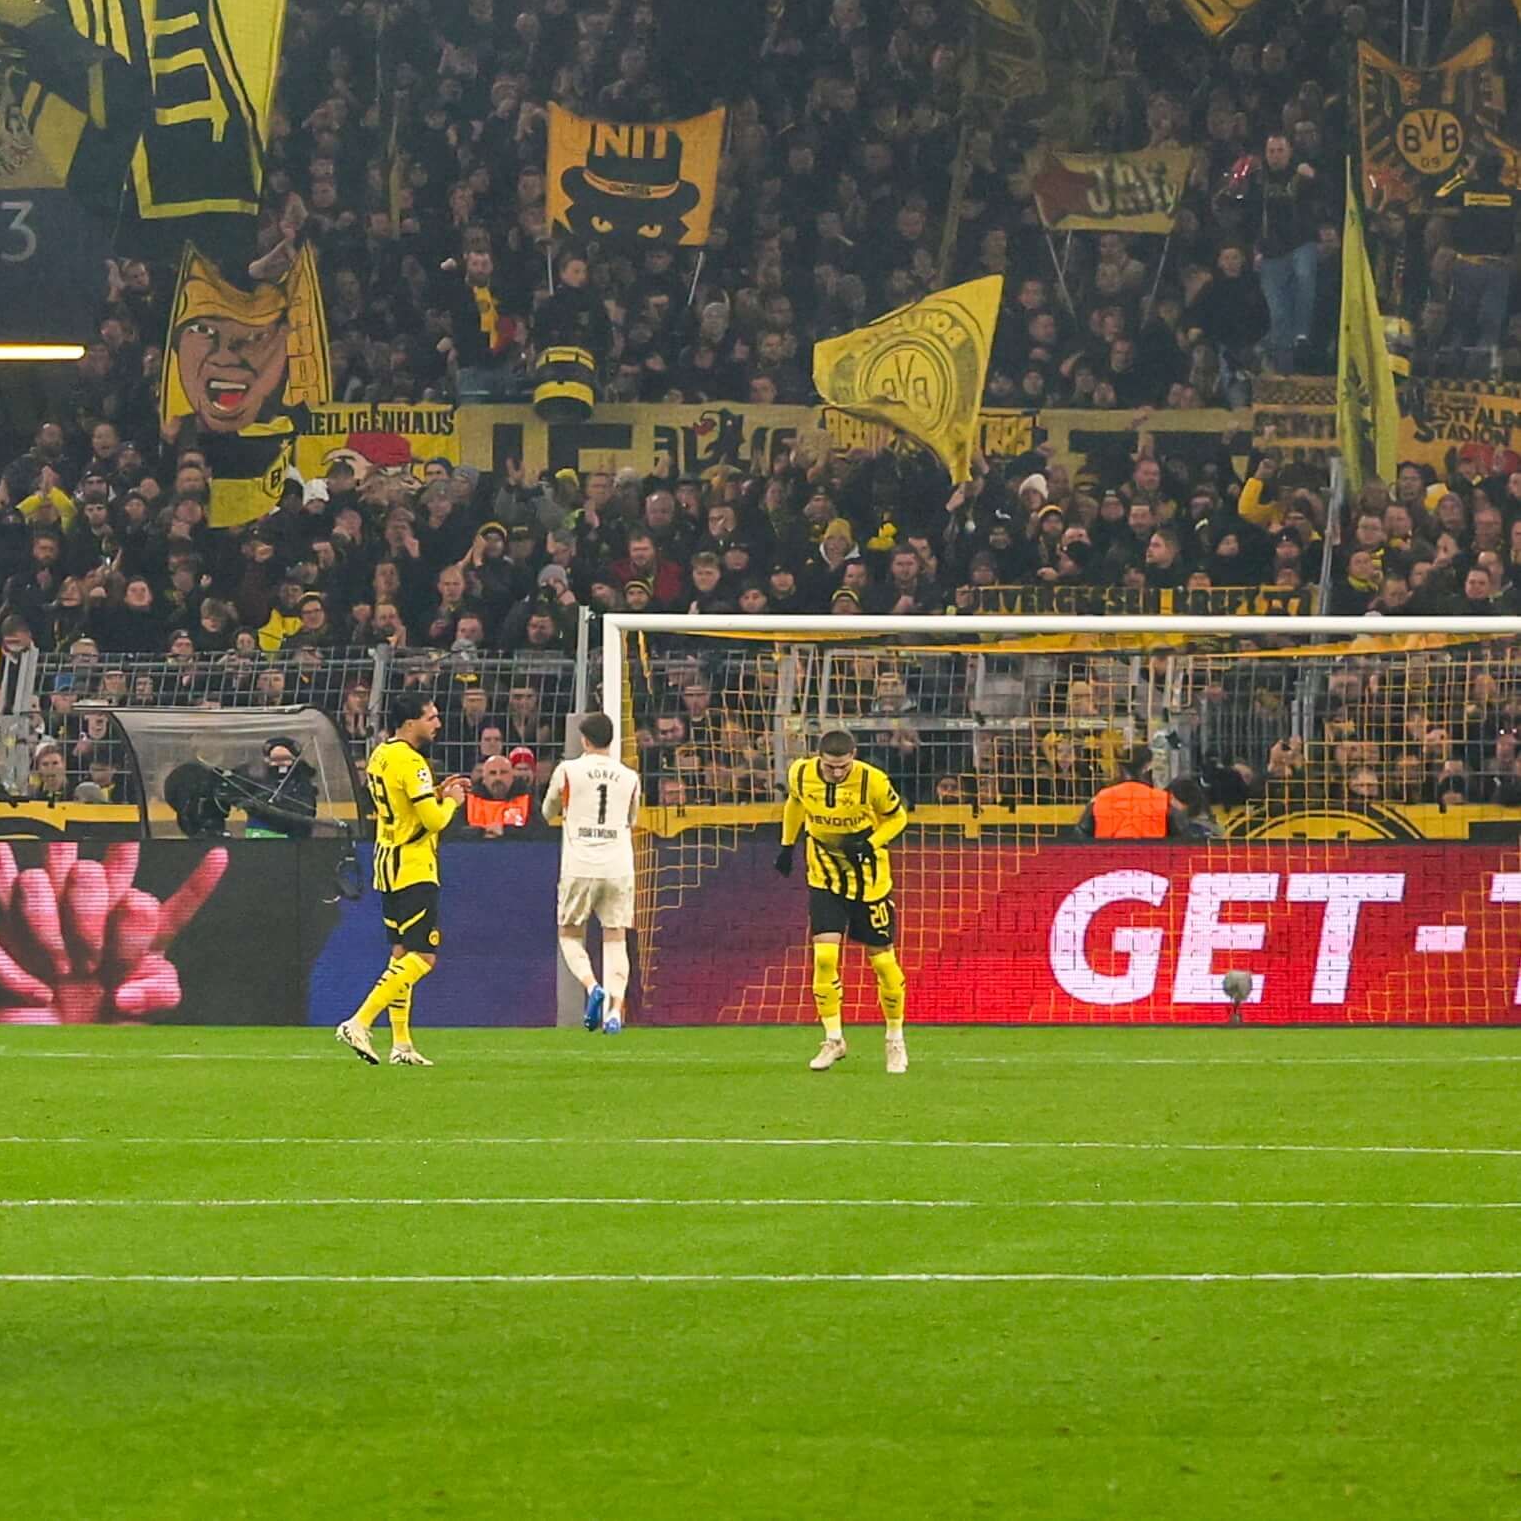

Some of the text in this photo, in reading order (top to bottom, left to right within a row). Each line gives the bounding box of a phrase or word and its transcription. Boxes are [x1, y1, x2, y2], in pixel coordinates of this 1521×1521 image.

[1403, 112, 1459, 153] BVB
[1414, 420, 1512, 447] STADION
[585, 769, 621, 783] KOBEL
[598, 783, 608, 825] 1
[578, 826, 618, 839] DORTMUND
[869, 903, 900, 929] 20
